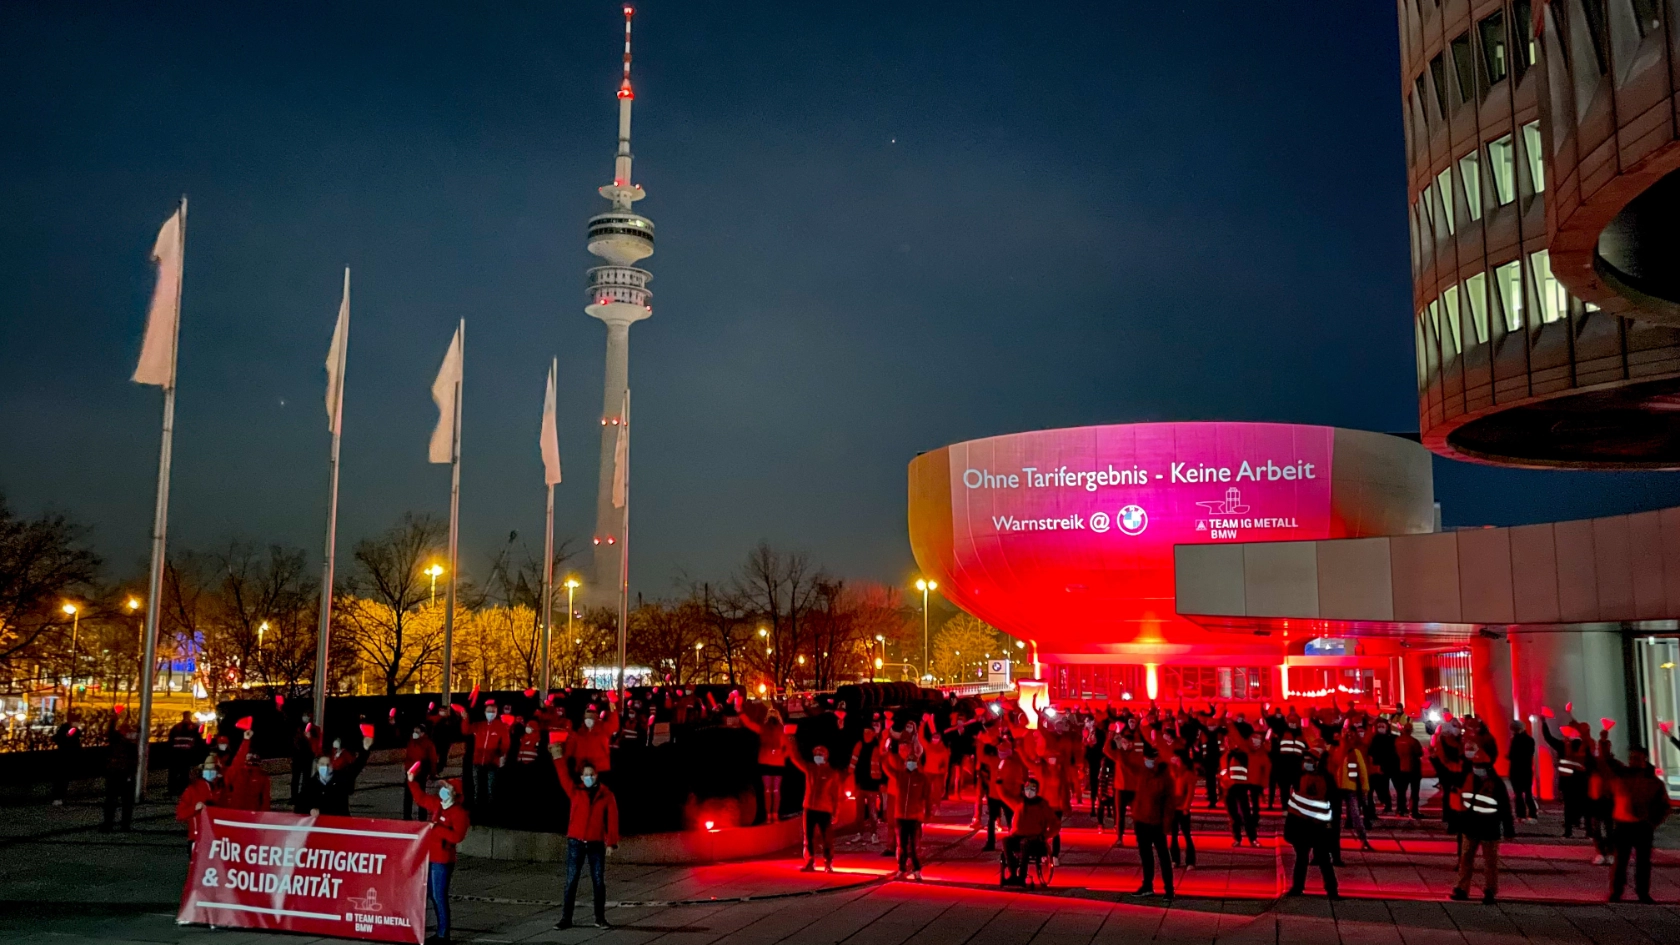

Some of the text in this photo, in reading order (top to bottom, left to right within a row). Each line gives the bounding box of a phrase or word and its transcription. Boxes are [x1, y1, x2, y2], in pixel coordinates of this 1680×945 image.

[963, 469, 1018, 489] Ohne
[1022, 465, 1148, 491] Tarifergebnis
[1171, 462, 1231, 484] Keine
[1236, 460, 1315, 482] Arbeit
[992, 512, 1110, 533] Warnstreik @
[1209, 518, 1298, 529] TEAM IG METALL
[1211, 530, 1237, 539] BMW
[208, 838, 386, 875] FÜR GERECHTIGKEIT
[202, 868, 343, 899] & SOLIDARITÄT
[354, 913, 411, 927] TEAM IG METALL
[355, 923, 373, 933] BMW
